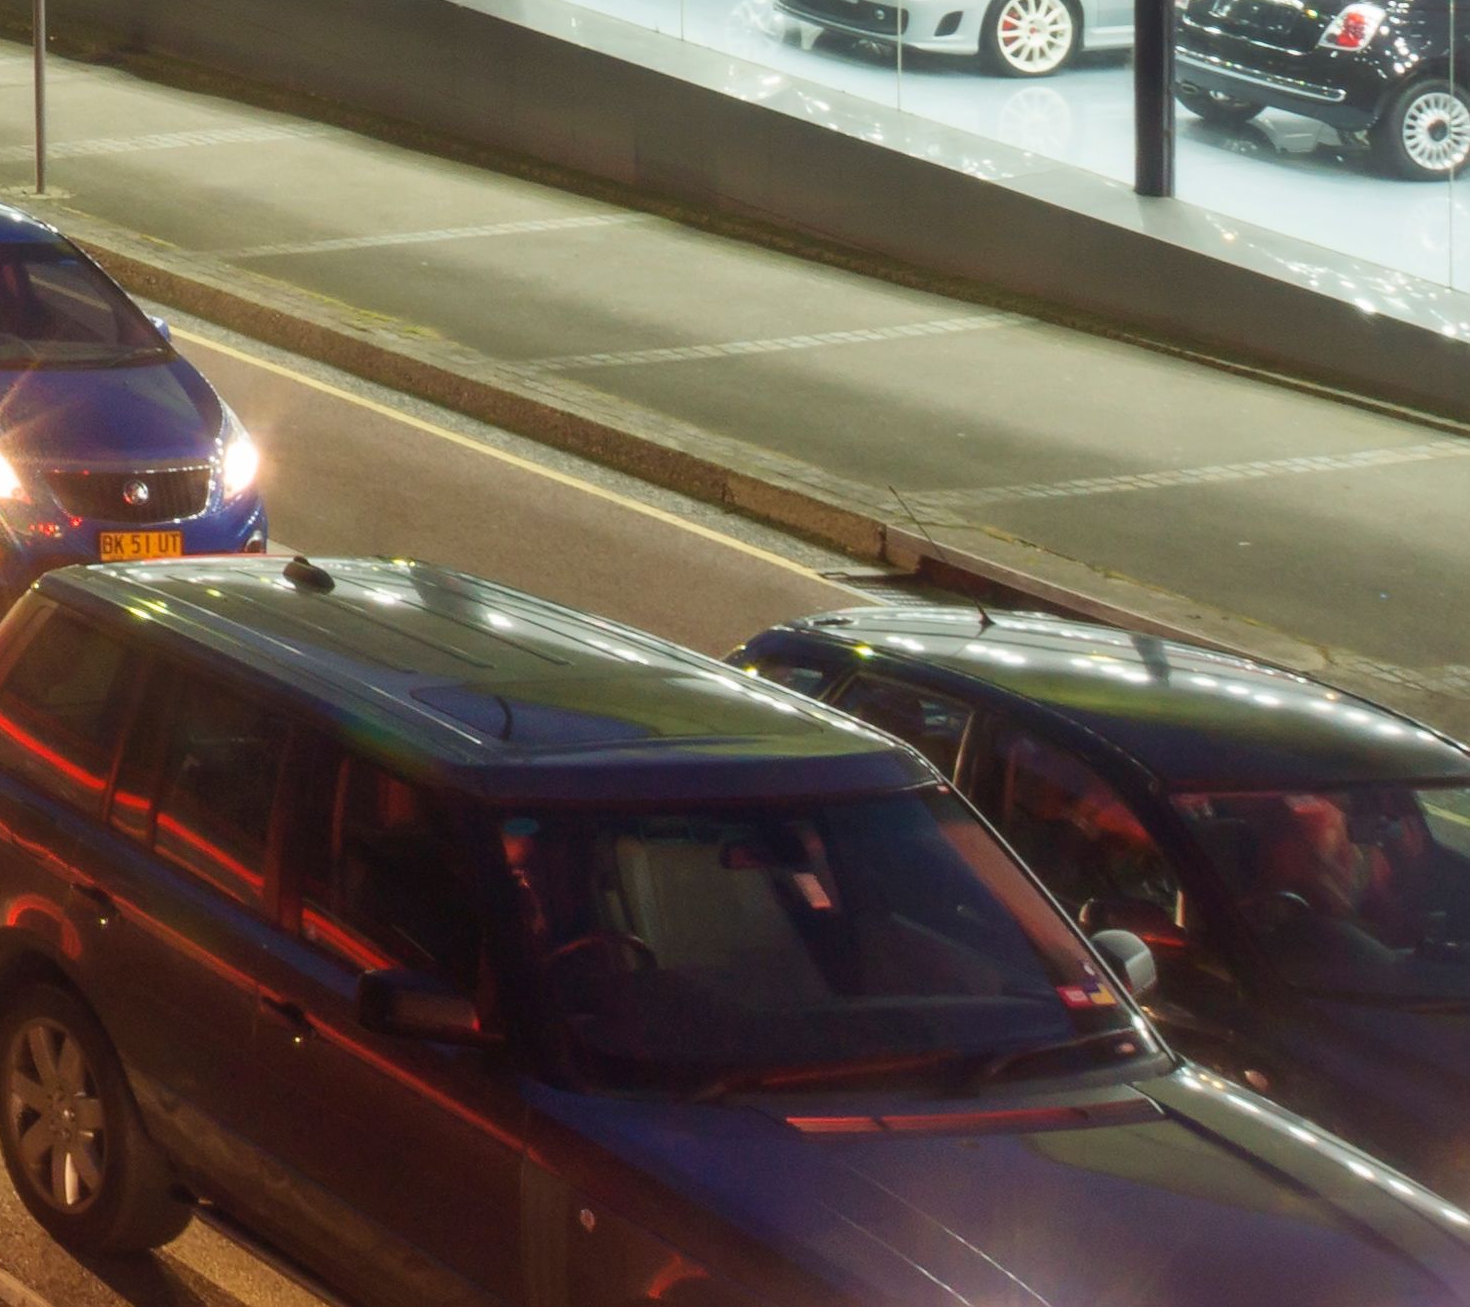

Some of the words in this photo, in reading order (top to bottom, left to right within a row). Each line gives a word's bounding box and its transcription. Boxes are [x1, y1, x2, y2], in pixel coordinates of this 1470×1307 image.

[102, 534, 124, 554] BK
[131, 534, 150, 554] 51
[158, 533, 181, 553] UT
